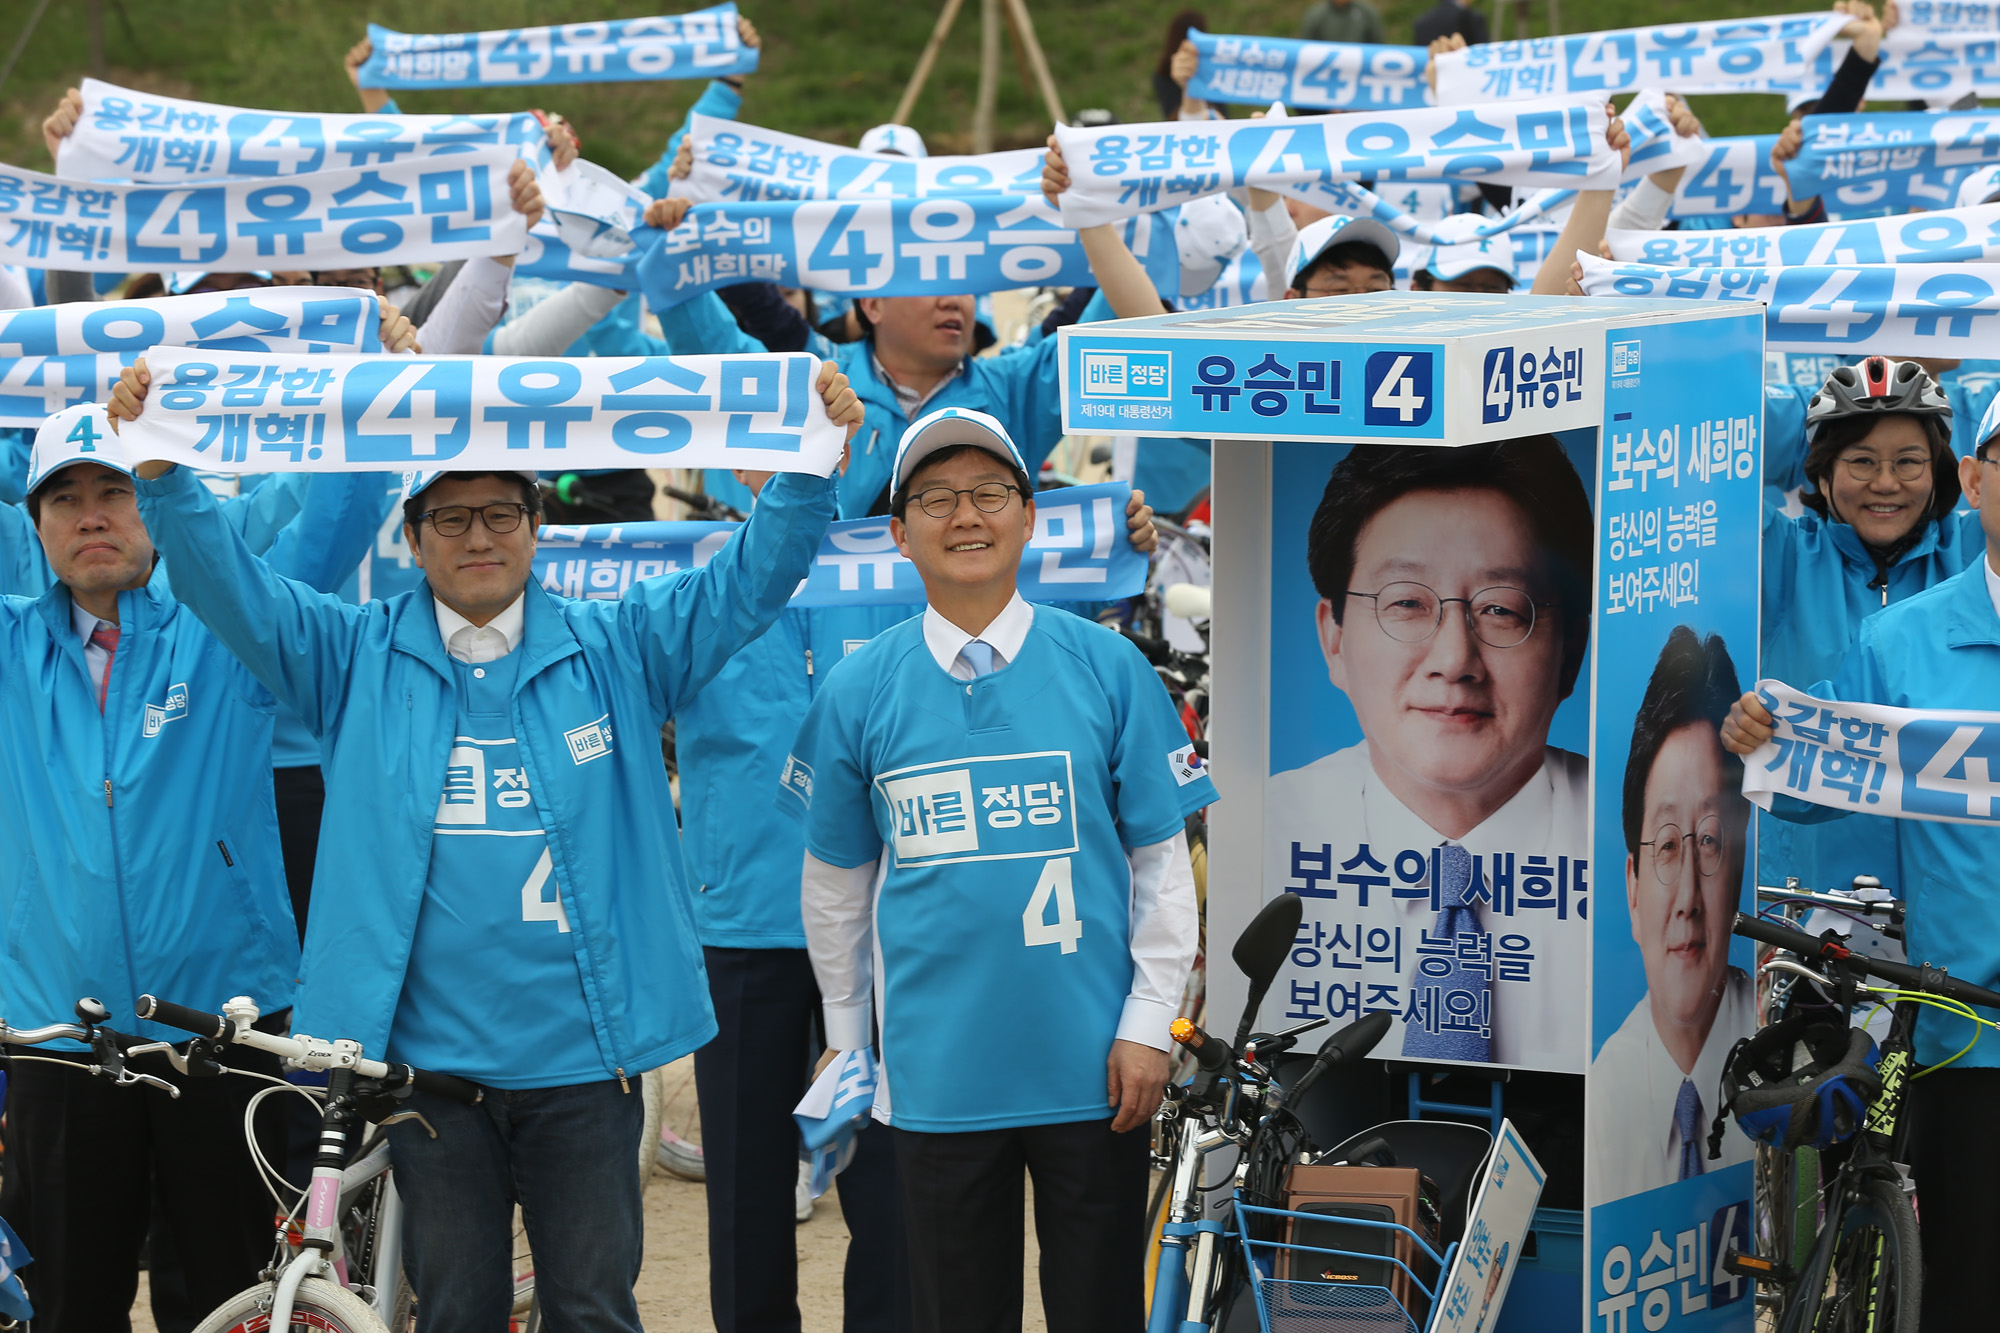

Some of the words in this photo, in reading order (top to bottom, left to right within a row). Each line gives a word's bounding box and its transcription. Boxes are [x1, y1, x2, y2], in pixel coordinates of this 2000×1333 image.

[383, 50, 472, 82] 새희망
[555, 11, 739, 74] 유승민
[1212, 37, 1287, 70] 보수의
[1208, 68, 1288, 99] 새희망
[1481, 64, 1556, 97] 개혁!
[93, 96, 220, 135] 용감한
[114, 135, 218, 175] 개혁!
[705, 131, 821, 183] 용감한
[1089, 134, 1221, 176] 용감한
[1341, 106, 1592, 180] 유승민
[1821, 147, 1925, 181] 새희망
[238, 170, 491, 255] 유승민
[1401, 189, 1420, 213] 4
[5, 218, 112, 262] 개혁!
[665, 210, 771, 255] 보수의
[674, 253, 787, 291] 새희망
[159, 362, 335, 411] 용감한
[357, 364, 459, 456] 4
[484, 356, 811, 455] 유승민
[1191, 353, 1341, 417] 유승민
[1371, 355, 1426, 422] 4
[1485, 351, 1511, 417] 4
[1517, 346, 1583, 409] 유승민
[65, 415, 103, 453] 4
[193, 413, 327, 463] 개혁!
[1080, 403, 1115, 418] 제19대
[1118, 404, 1172, 420] 대통령선거
[1608, 424, 1680, 492] 보수의
[1687, 415, 1756, 484] 새희망
[1609, 507, 1661, 561] 당신의
[1666, 499, 1718, 552] 능력을
[1606, 559, 1699, 615] 보여주세요!
[574, 732, 601, 753] 바른
[1764, 736, 1887, 805] 개혁!
[1915, 725, 2000, 817] 4
[897, 790, 967, 837] 바른
[982, 781, 1064, 829] 정당
[521, 844, 572, 934] 4
[1285, 841, 1442, 912] 보수의
[1022, 856, 1083, 955] 4
[1290, 921, 1400, 973] 당신의
[1416, 928, 1535, 983] 능력을
[1285, 979, 1492, 1039] 보여주세요!
[1597, 1221, 1708, 1333] 유승민
